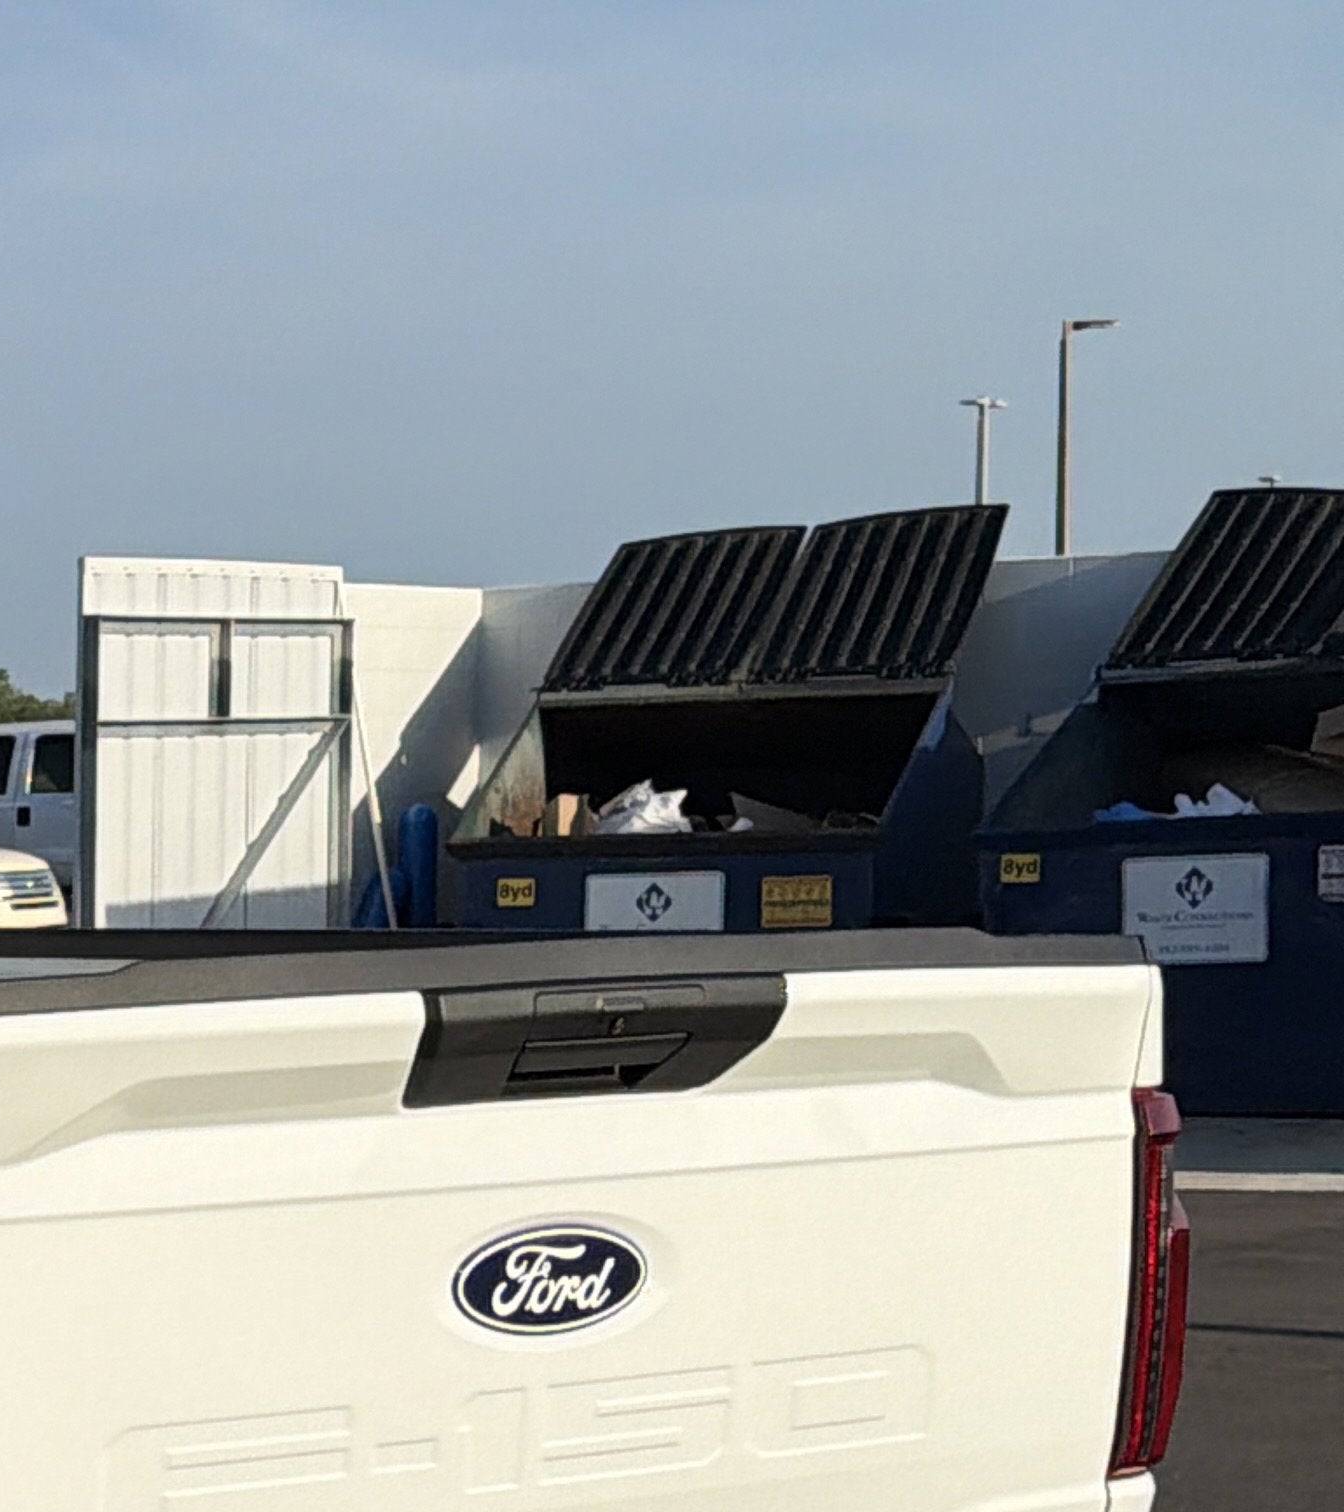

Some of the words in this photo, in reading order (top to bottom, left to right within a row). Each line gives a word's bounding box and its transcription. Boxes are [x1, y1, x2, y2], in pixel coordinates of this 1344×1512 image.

[1004, 858, 1037, 877] 8yd
[499, 882, 532, 901] 8yd
[490, 1243, 617, 1316] Ford
